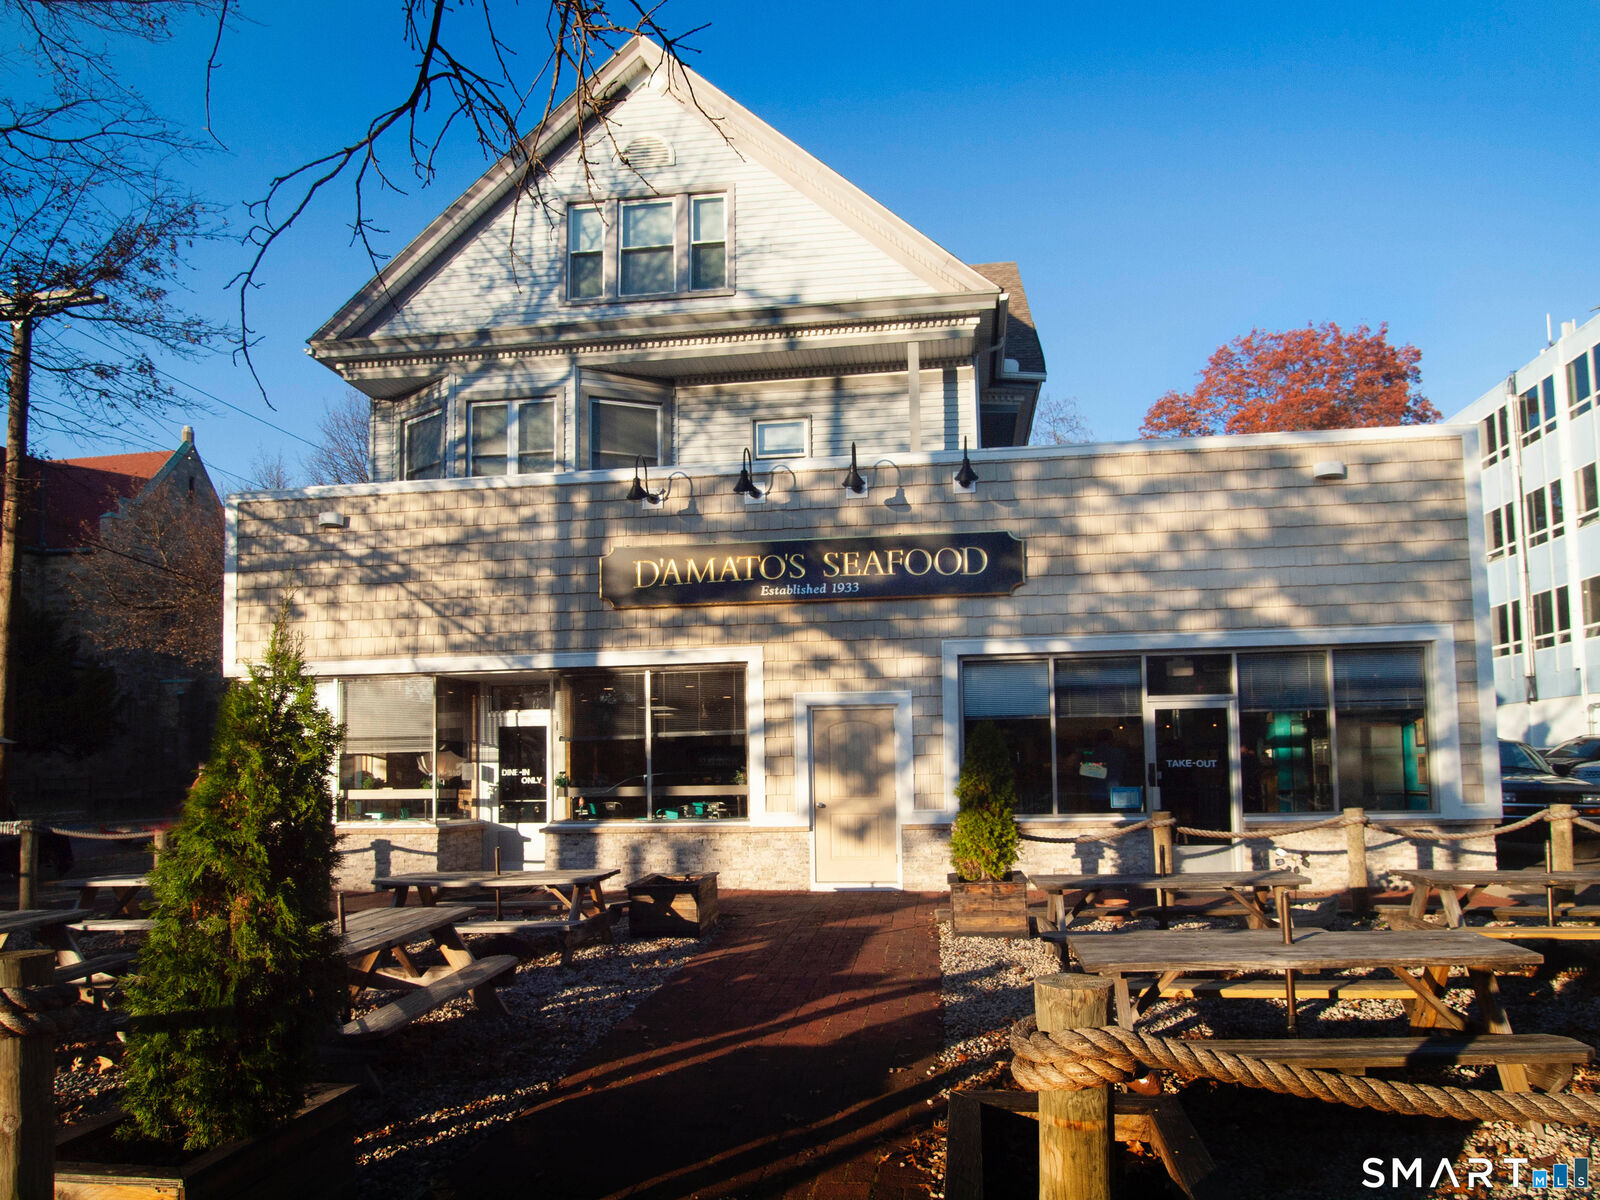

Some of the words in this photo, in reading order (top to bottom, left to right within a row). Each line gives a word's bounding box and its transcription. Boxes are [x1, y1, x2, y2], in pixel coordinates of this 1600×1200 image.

[632, 553, 806, 589] D'AMATO'S
[823, 546, 988, 578] SEAFOOD
[760, 584, 827, 596] Established
[831, 582, 860, 594] 1933
[1166, 760, 1217, 768] TAKE-OUT
[501, 768, 530, 776] DINE-IN
[521, 776, 542, 784] ONLY
